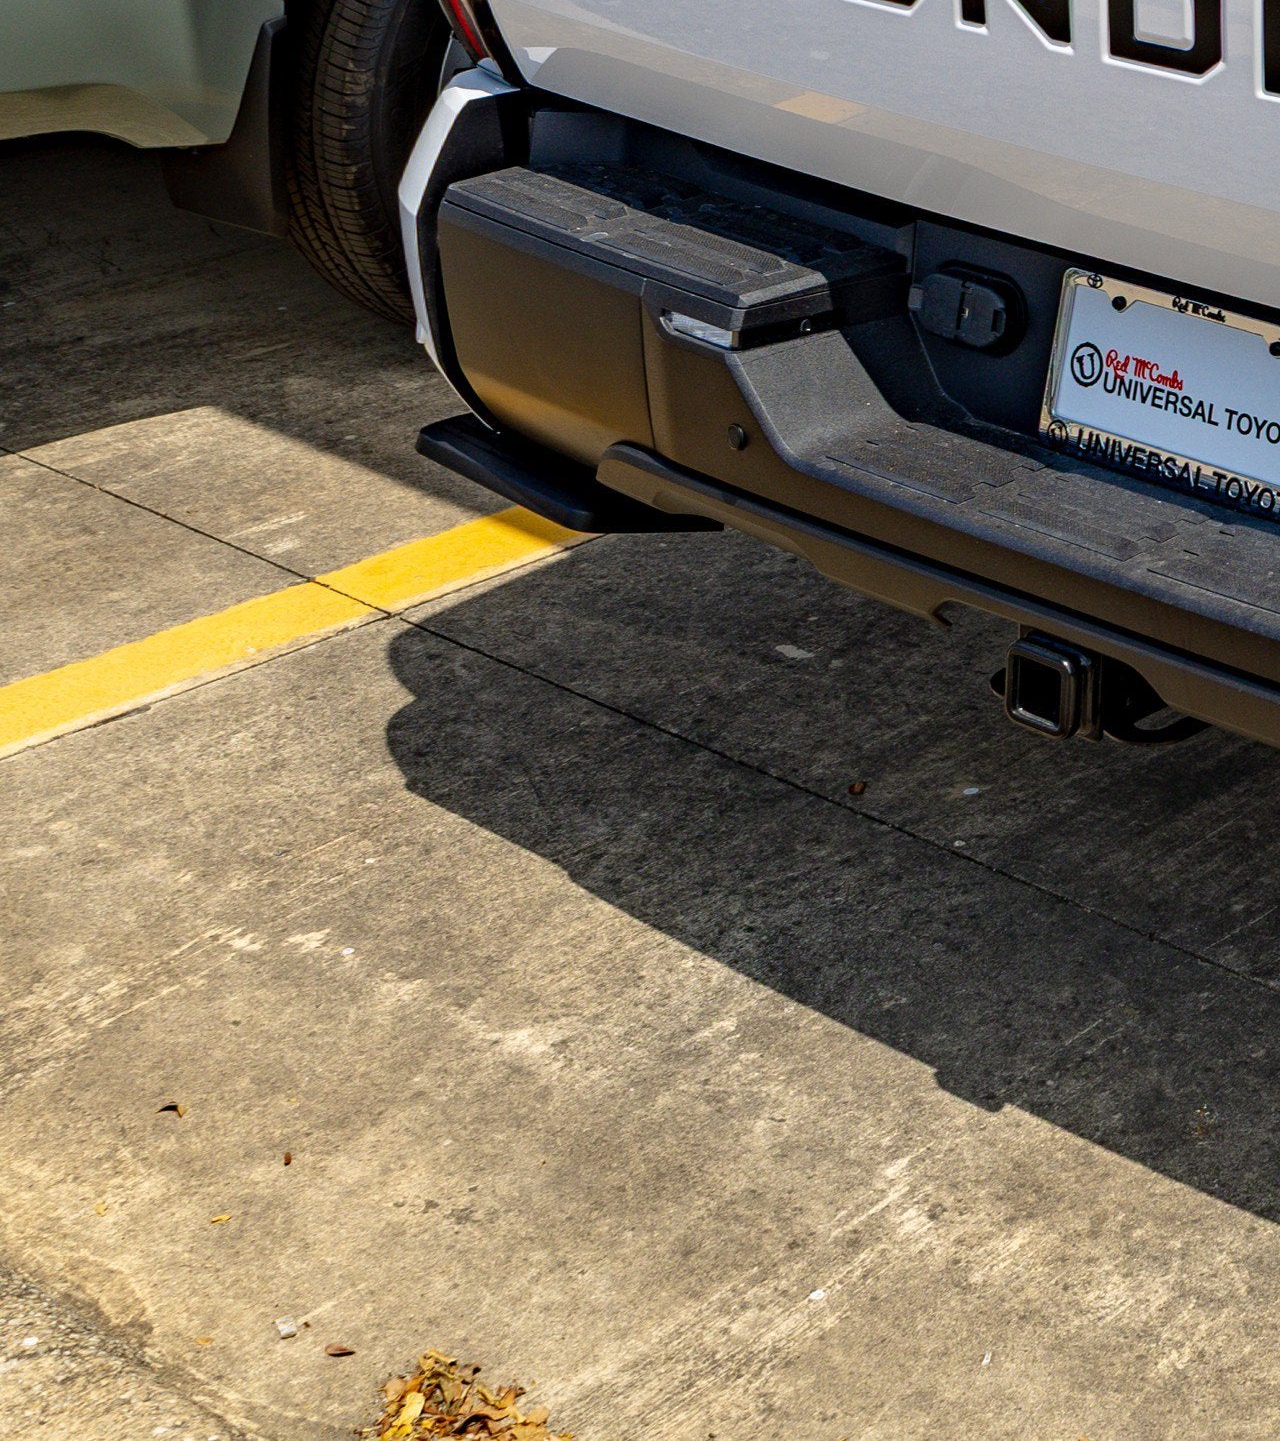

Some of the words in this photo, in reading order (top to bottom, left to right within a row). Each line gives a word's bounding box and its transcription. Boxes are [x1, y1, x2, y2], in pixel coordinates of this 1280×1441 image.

[1106, 348, 1129, 379] Red
[1131, 356, 1184, 391] McCombs
[1103, 371, 1219, 427] UNIVERSAL
[1075, 430, 1208, 491] UNIVERSAL
